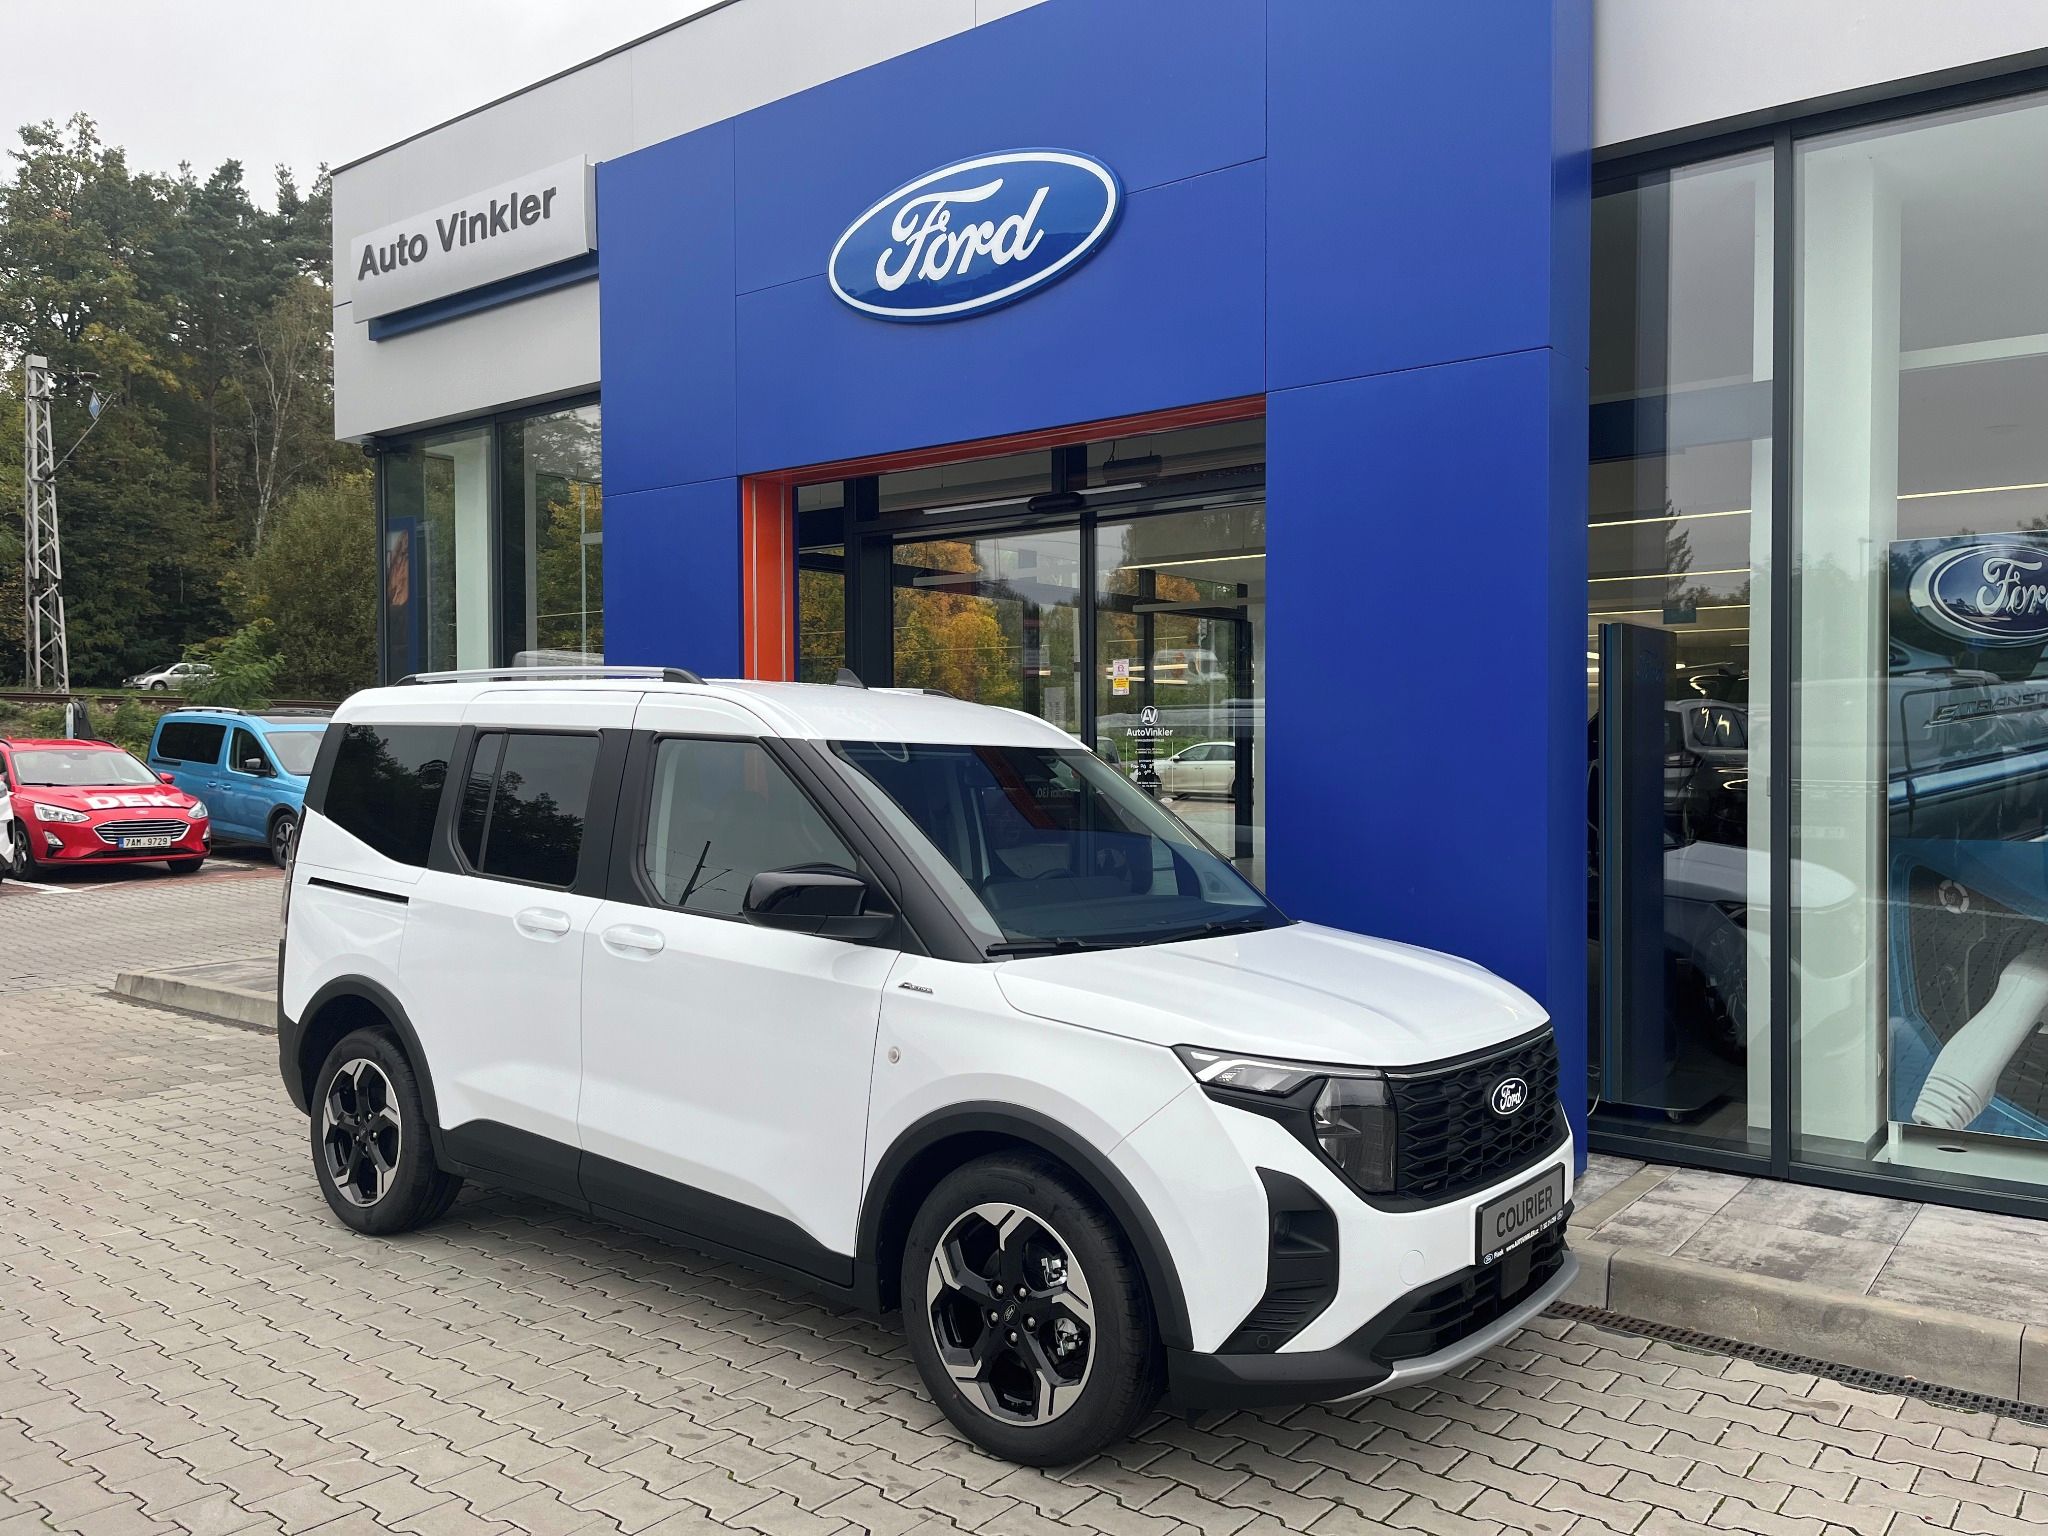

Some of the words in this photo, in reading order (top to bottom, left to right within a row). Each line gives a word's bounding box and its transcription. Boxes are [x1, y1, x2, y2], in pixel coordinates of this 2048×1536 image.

[358, 232, 428, 281] Auto
[435, 186, 557, 253] Vinkler
[875, 178, 1050, 291] Ford
[1976, 557, 2048, 616] For
[1126, 727, 1174, 737] AutoVinkler
[85, 794, 181, 809] DEK
[147, 837, 168, 846] 9729
[1500, 1082, 1522, 1111] Ford
[1496, 1185, 1553, 1238] COURIER
